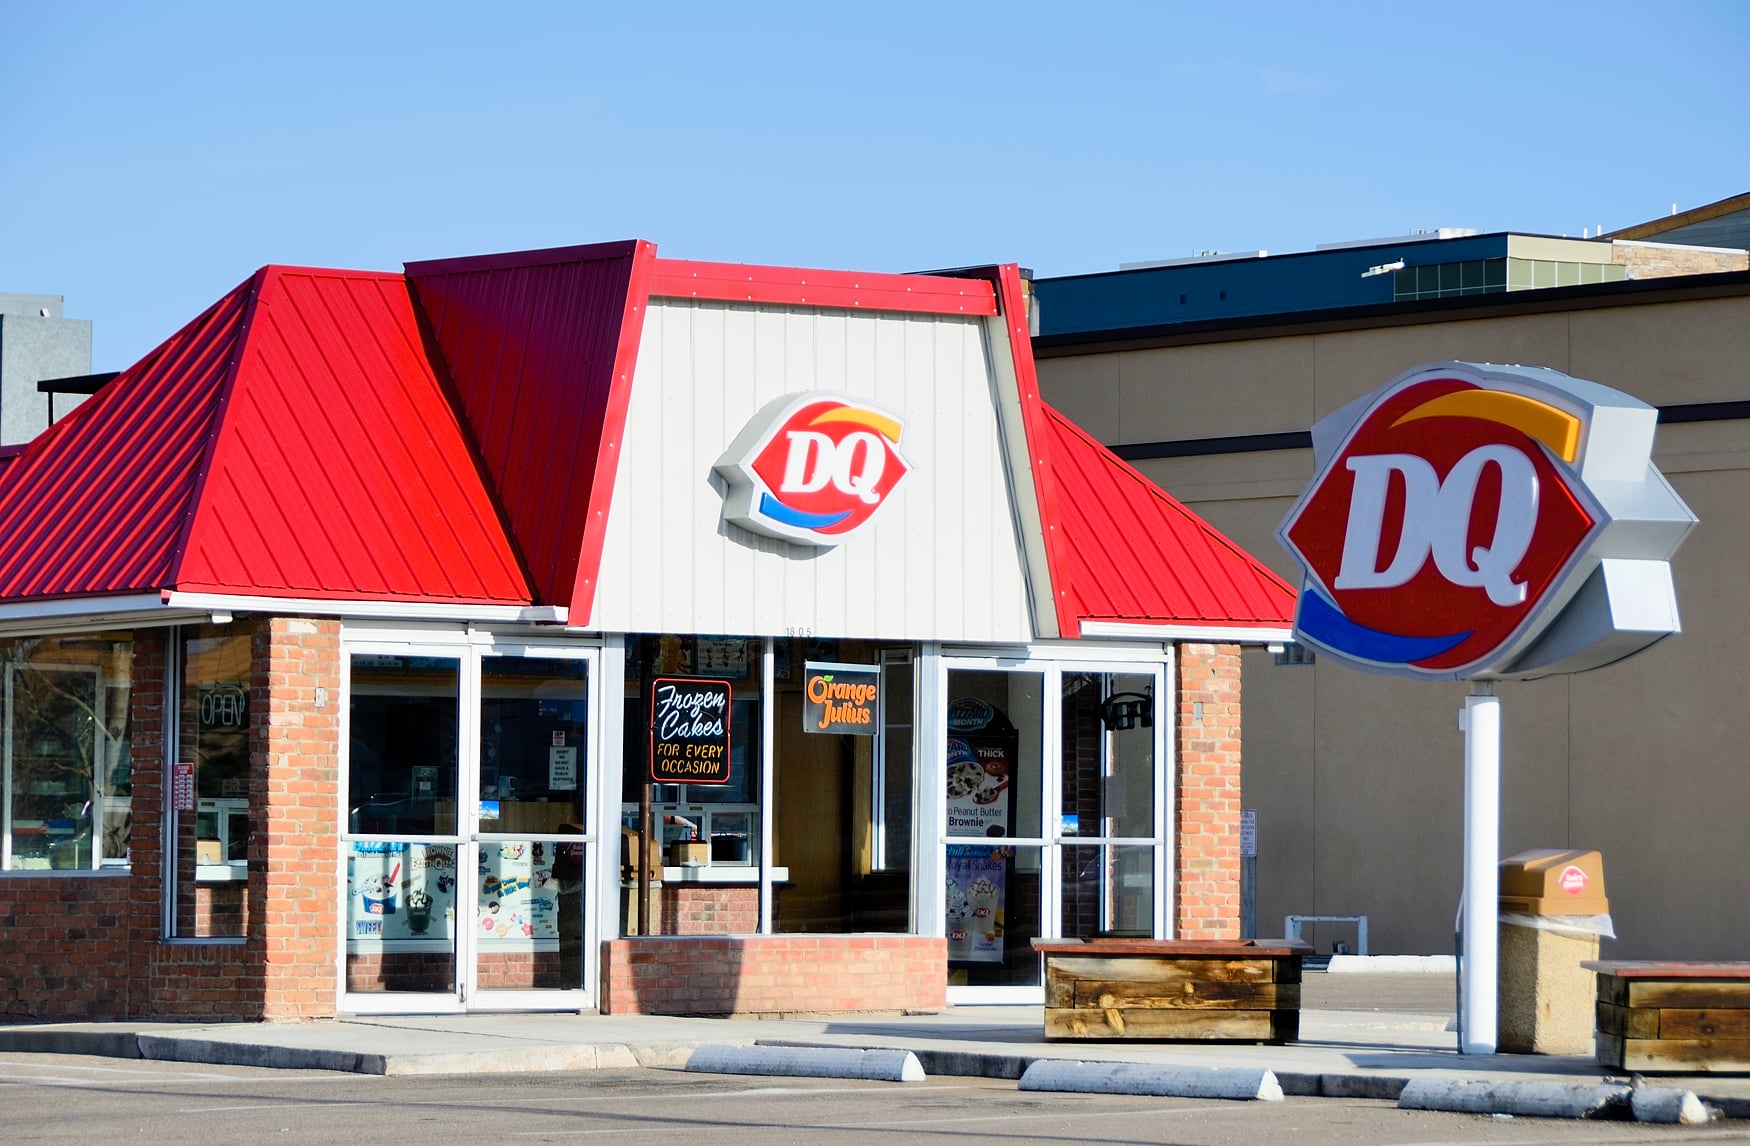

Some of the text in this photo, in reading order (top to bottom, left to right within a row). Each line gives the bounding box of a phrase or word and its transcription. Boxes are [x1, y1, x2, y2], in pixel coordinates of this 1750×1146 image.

[779, 430, 881, 505] DQ
[1334, 443, 1540, 607] DQ
[657, 685, 726, 718] Frozen
[807, 675, 877, 706] Orange
[201, 694, 243, 726] OPEN
[661, 710, 724, 740] Cakes
[818, 699, 871, 729] Julius
[657, 743, 724, 759] FOR EVERY
[661, 758, 720, 774] OCCASION
[978, 749, 1005, 758] THICK
[949, 817, 984, 827] Brownie
[954, 807, 978, 817] Peanut
[980, 808, 1002, 817] Butter
